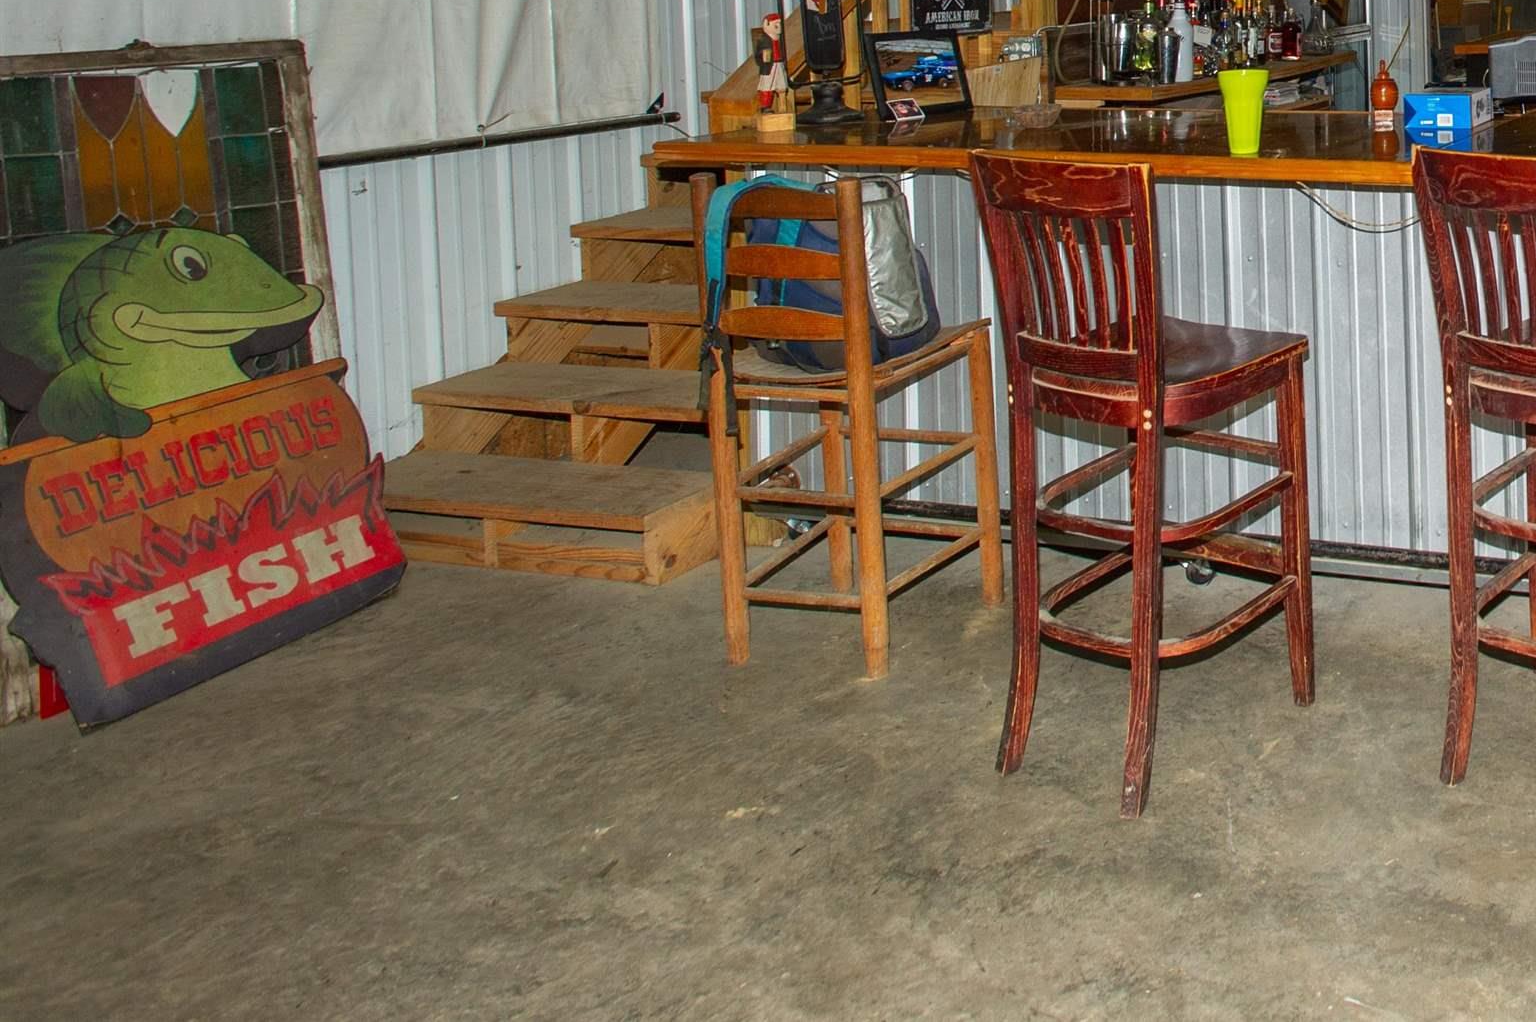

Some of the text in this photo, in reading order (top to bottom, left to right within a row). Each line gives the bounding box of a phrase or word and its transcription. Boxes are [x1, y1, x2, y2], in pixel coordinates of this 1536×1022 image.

[925, 10, 962, 24] AMERICAN
[42, 397, 344, 538] DELICIOUS
[111, 514, 375, 660] FISH
